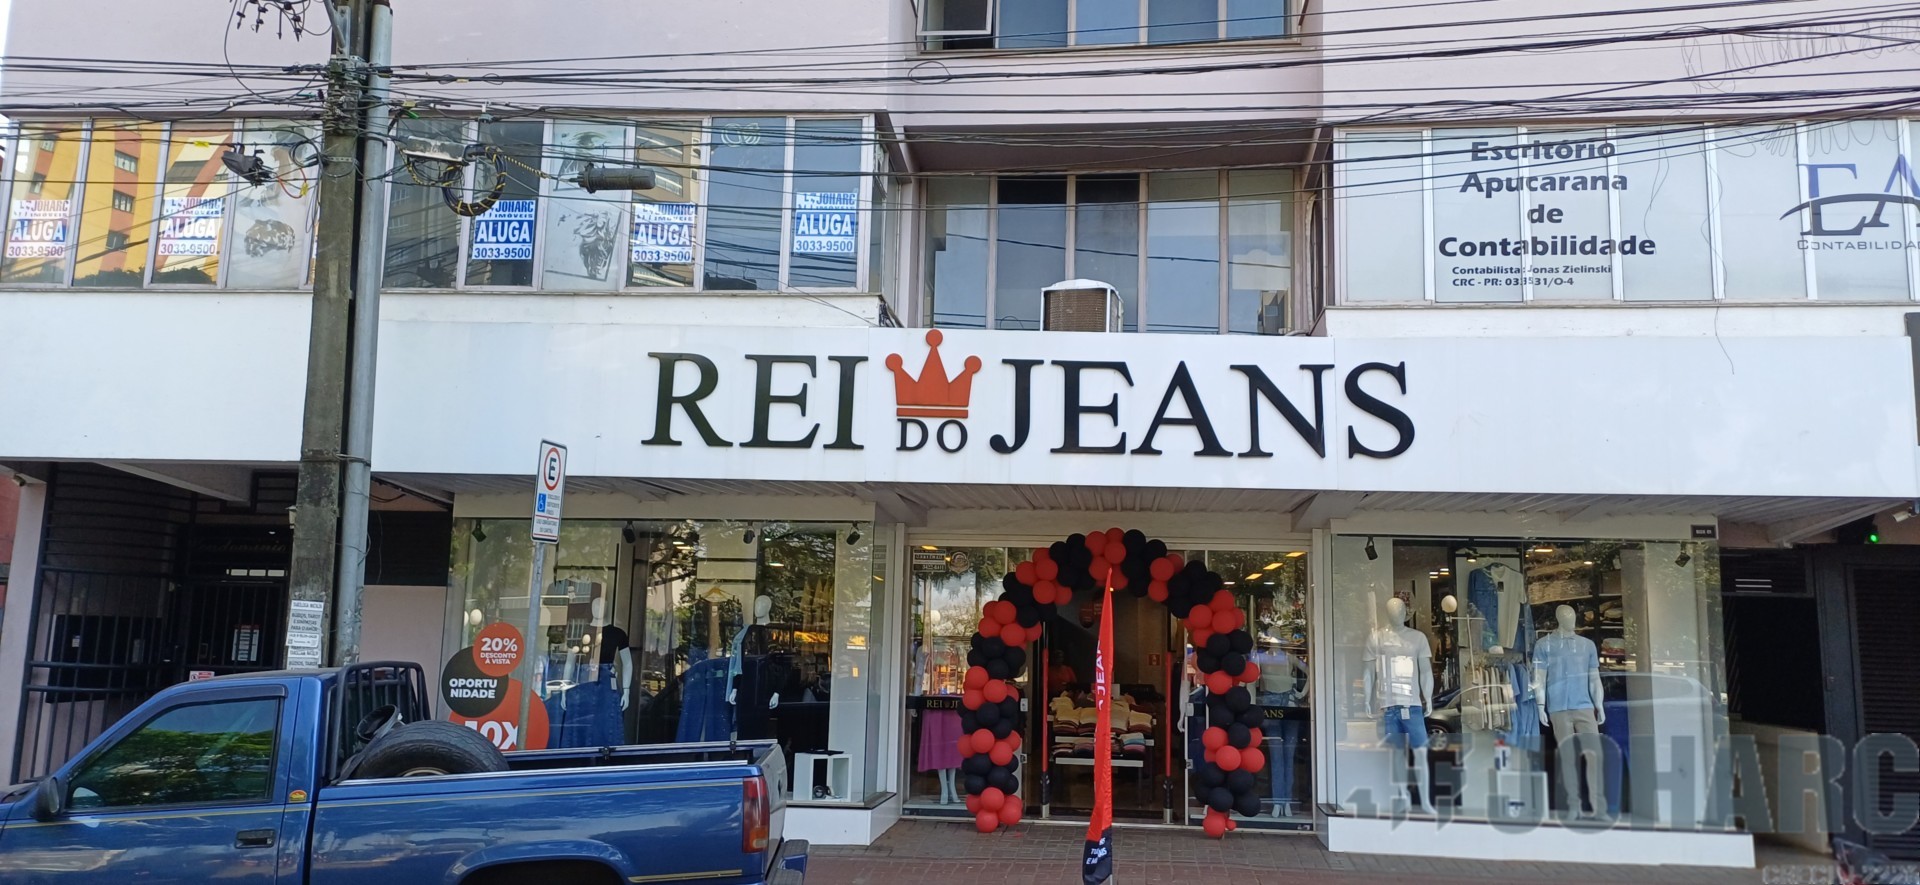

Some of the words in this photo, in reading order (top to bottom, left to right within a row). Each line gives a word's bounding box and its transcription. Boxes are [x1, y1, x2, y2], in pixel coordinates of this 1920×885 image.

[1459, 173, 1628, 199] Apucarana
[816, 193, 855, 206] JOHARC
[495, 201, 534, 213] JOHARC
[1527, 204, 1564, 223] de
[10, 219, 65, 241] ALUGA
[163, 218, 216, 238] ALUGA
[797, 213, 853, 235] ALUGA
[476, 221, 531, 243] ALUGA
[636, 224, 690, 246] ALUGA
[8, 246, 64, 257] 3033-9500
[160, 243, 216, 254] 3033-9500
[795, 240, 853, 251] 3033-9500
[1438, 235, 1656, 257] Contabilidade
[474, 247, 531, 258] 3033-9500
[634, 250, 691, 262] 3033-9500
[1527, 265, 1560, 274] Jonas
[1562, 265, 1612, 274] Zielinski
[1452, 278, 1476, 287] CRC
[1484, 278, 1502, 287] PR:
[641, 351, 869, 450] REI
[896, 418, 968, 454] DO
[989, 359, 1417, 460] JEANS
[548, 457, 557, 481] E
[481, 637, 518, 652] 20%
[449, 679, 497, 688] OPORTU
[450, 689, 496, 698] NIDADE
[1264, 709, 1284, 718] ANS
